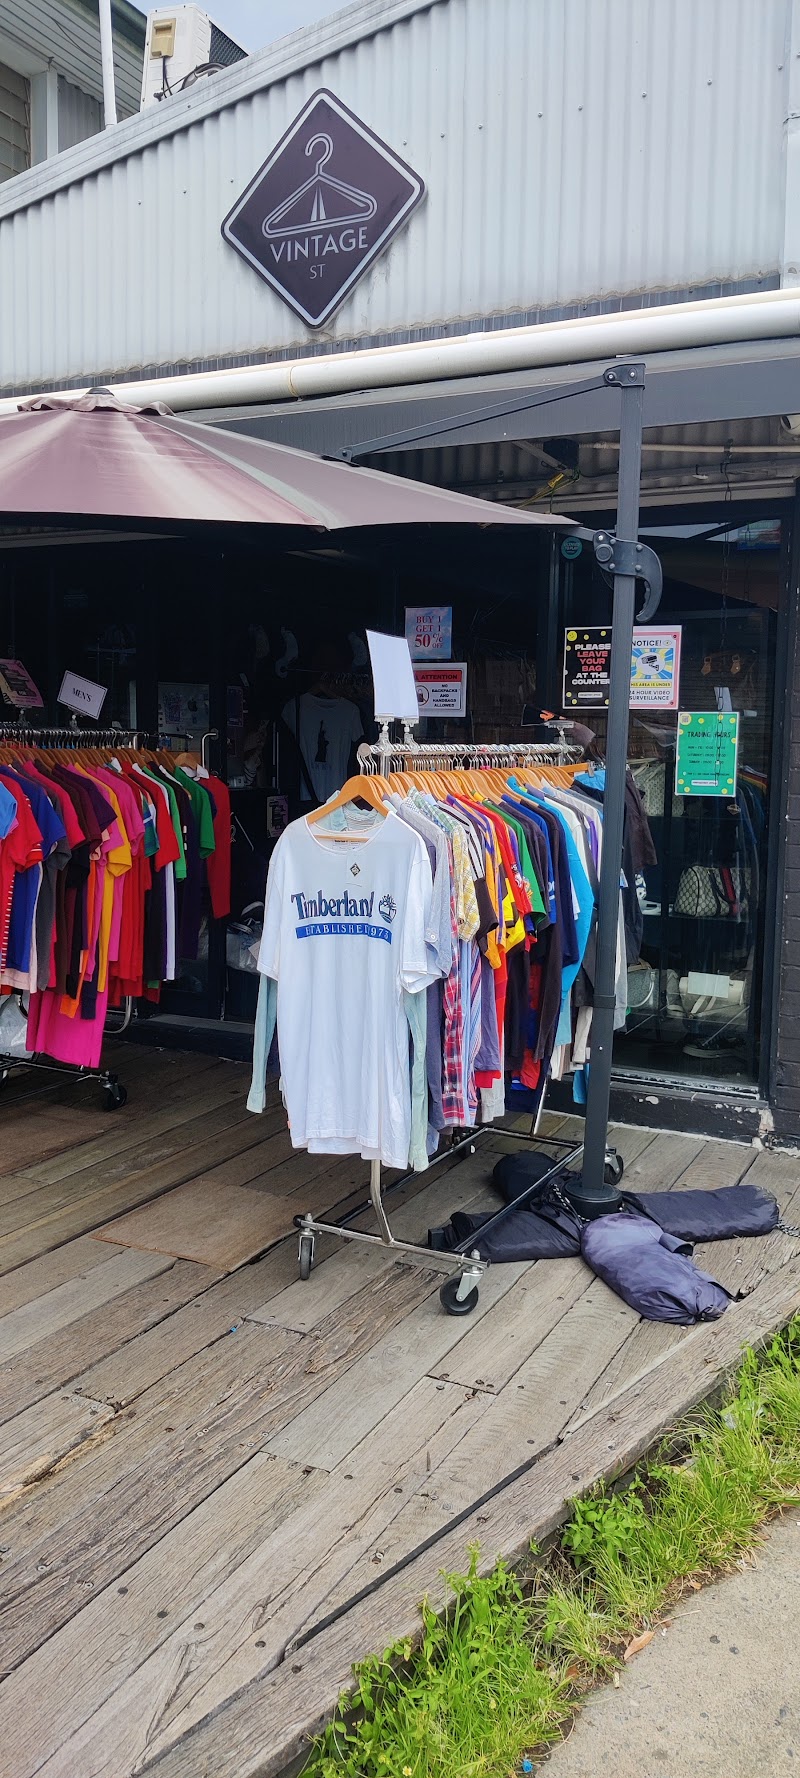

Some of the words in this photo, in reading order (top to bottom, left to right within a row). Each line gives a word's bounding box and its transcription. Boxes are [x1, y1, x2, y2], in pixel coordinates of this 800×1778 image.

[269, 226, 369, 264] VINTAGE
[309, 263, 326, 280] ST
[72, 687, 93, 703] MEN'S
[369, 927, 389, 940] 973
